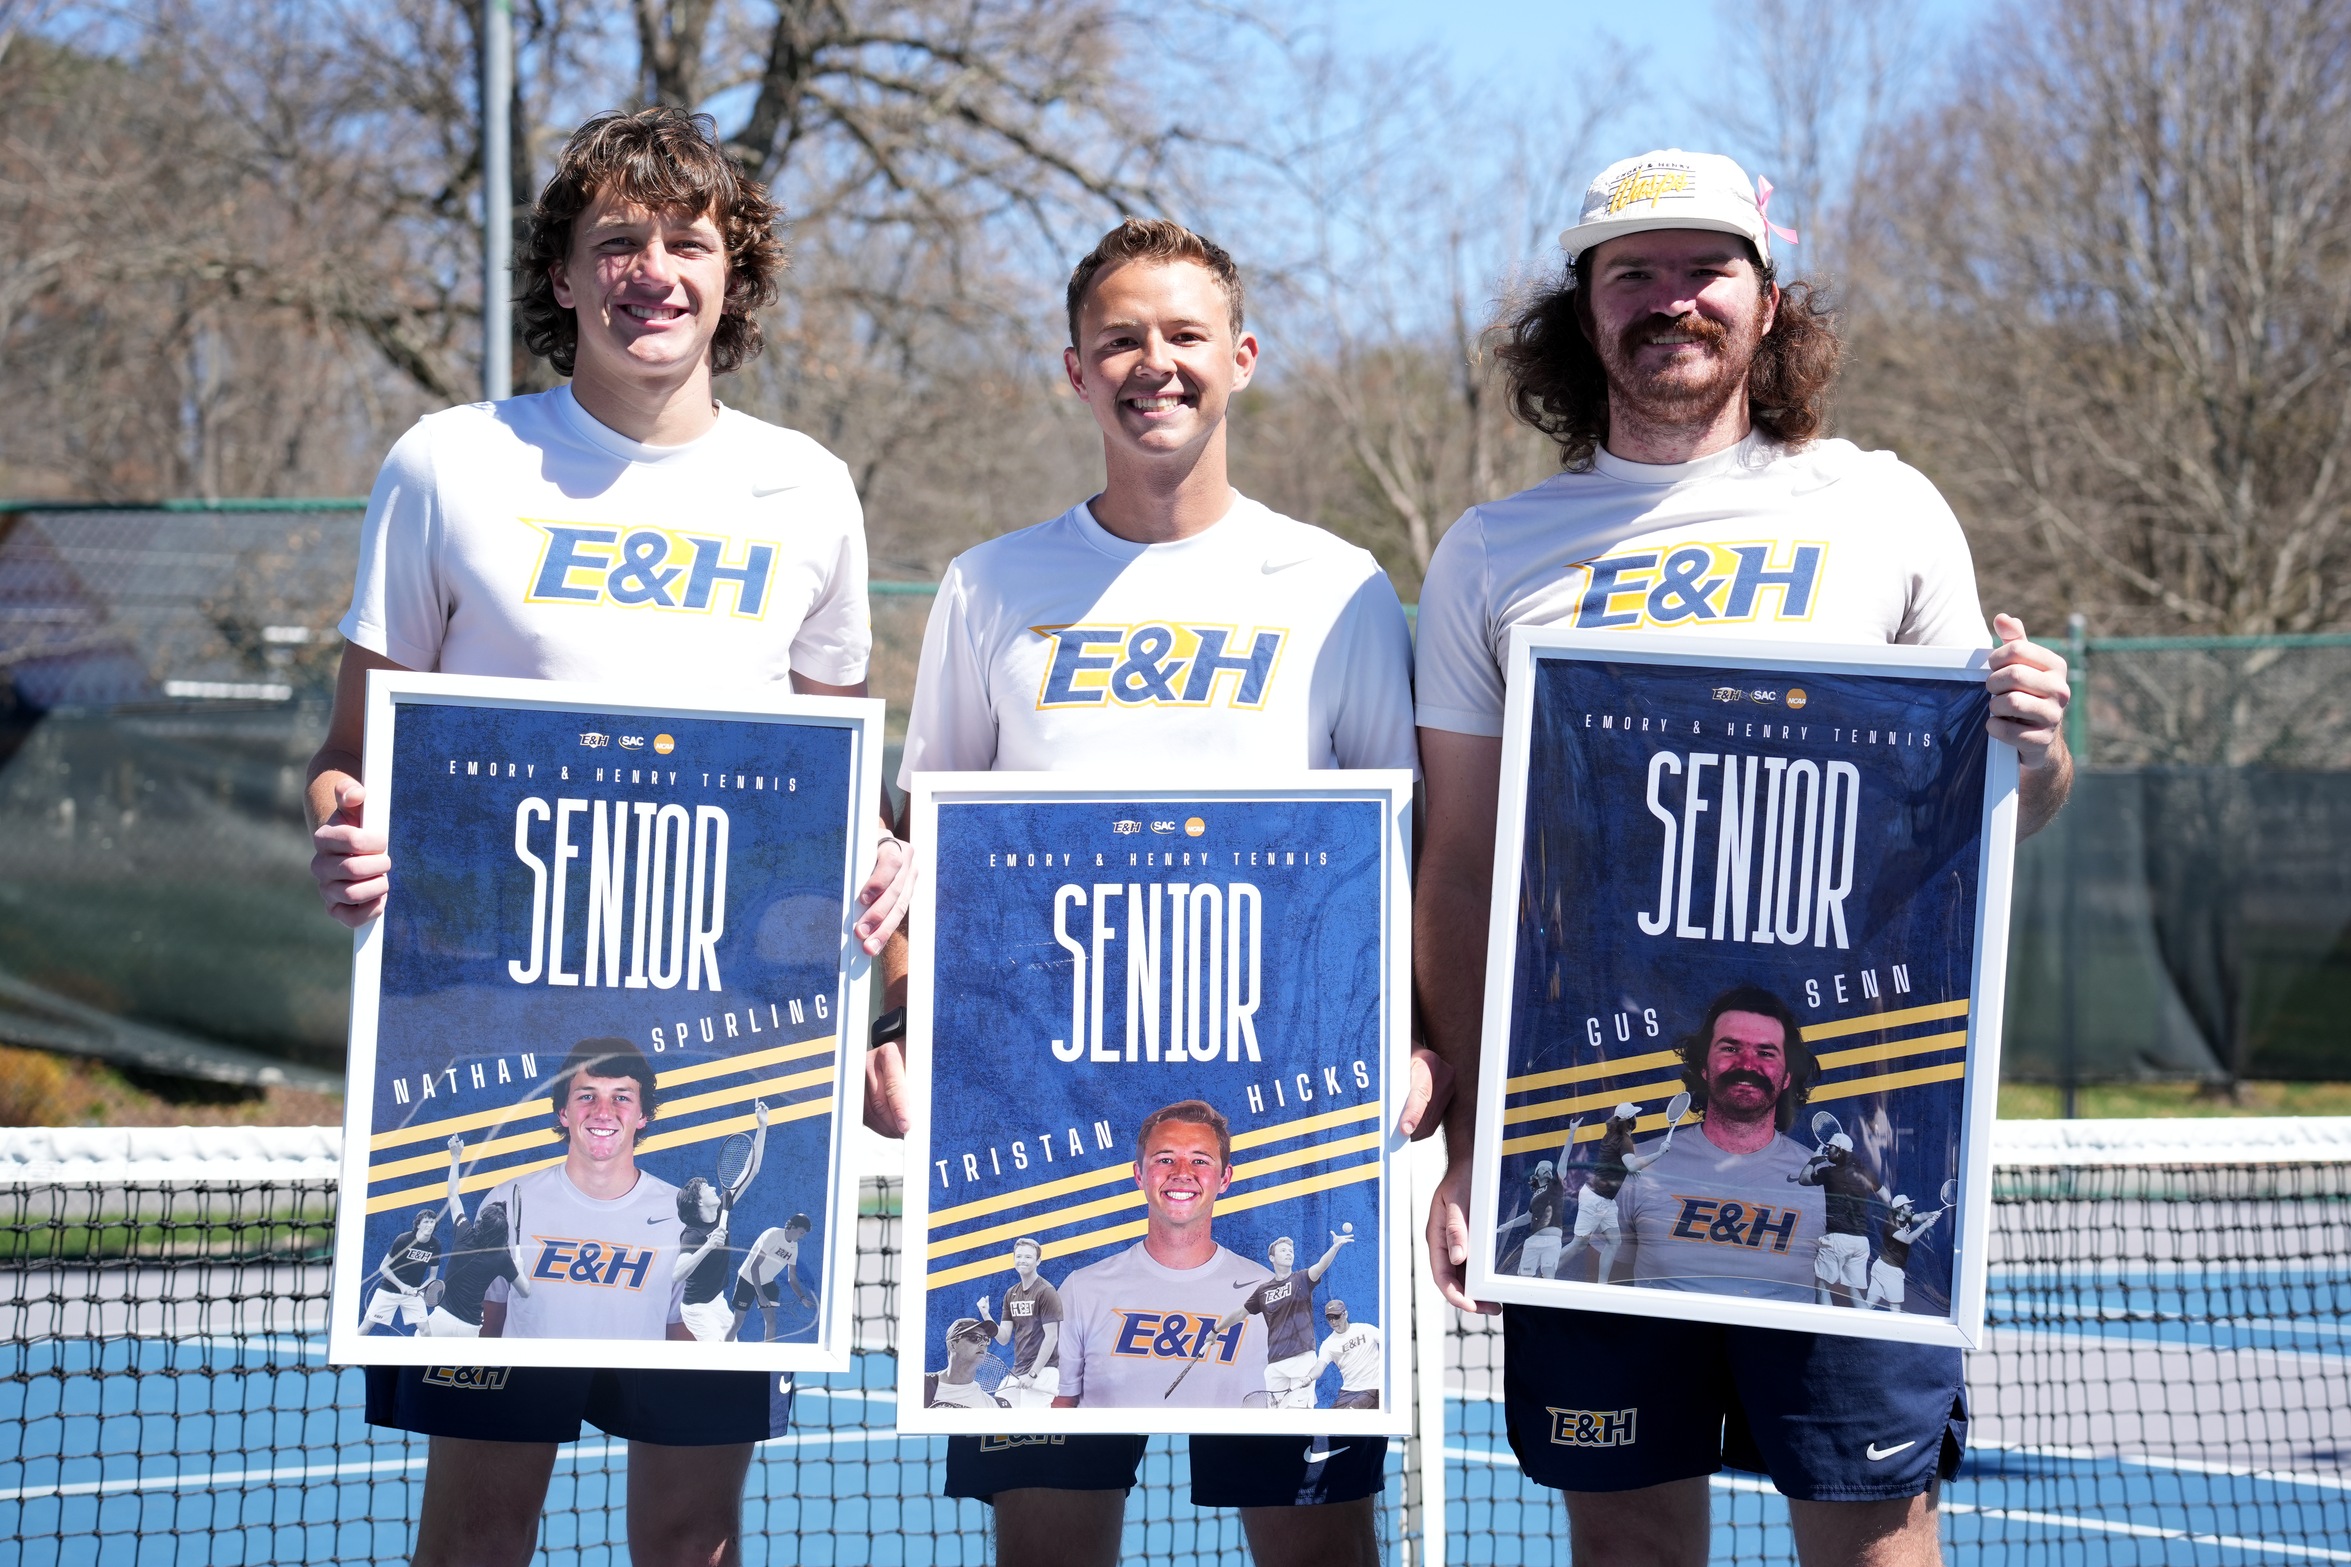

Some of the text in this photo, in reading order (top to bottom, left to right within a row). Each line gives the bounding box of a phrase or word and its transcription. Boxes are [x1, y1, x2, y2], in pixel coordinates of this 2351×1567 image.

[1609, 168, 1689, 215] Wasps
[520, 519, 780, 621] E&H
[1570, 541, 1828, 630] E&H
[1030, 620, 1289, 711] E&H
[1712, 688, 1807, 705] E&H SAC NCAA
[579, 733, 610, 748] E&H
[621, 735, 644, 746] SAC
[1585, 714, 1931, 747] EMORY & HENRY TENNIS
[449, 760, 796, 792] EMORY & HENRY TENNIS
[1112, 820, 1142, 834] E&H
[1153, 821, 1176, 831] SAC
[1637, 750, 1860, 950] SENIOR
[989, 851, 1327, 868] EMORY & HENRY TENNIS
[507, 796, 730, 992] SENIOR
[1051, 882, 1262, 1063] SENIOR
[1586, 963, 1911, 1047] GUS SENN
[392, 993, 829, 1105] NATHAN SPURLING
[935, 1060, 1370, 1189] TRISTAN HICKS
[1669, 1196, 1801, 1254] E&H
[408, 1248, 432, 1262] E&H
[531, 1236, 658, 1291] E&H
[1265, 1282, 1292, 1304] E&H
[1112, 1309, 1248, 1366] E&H
[1341, 1334, 1366, 1353] E&H
[1546, 1407, 1637, 1447] E&H
